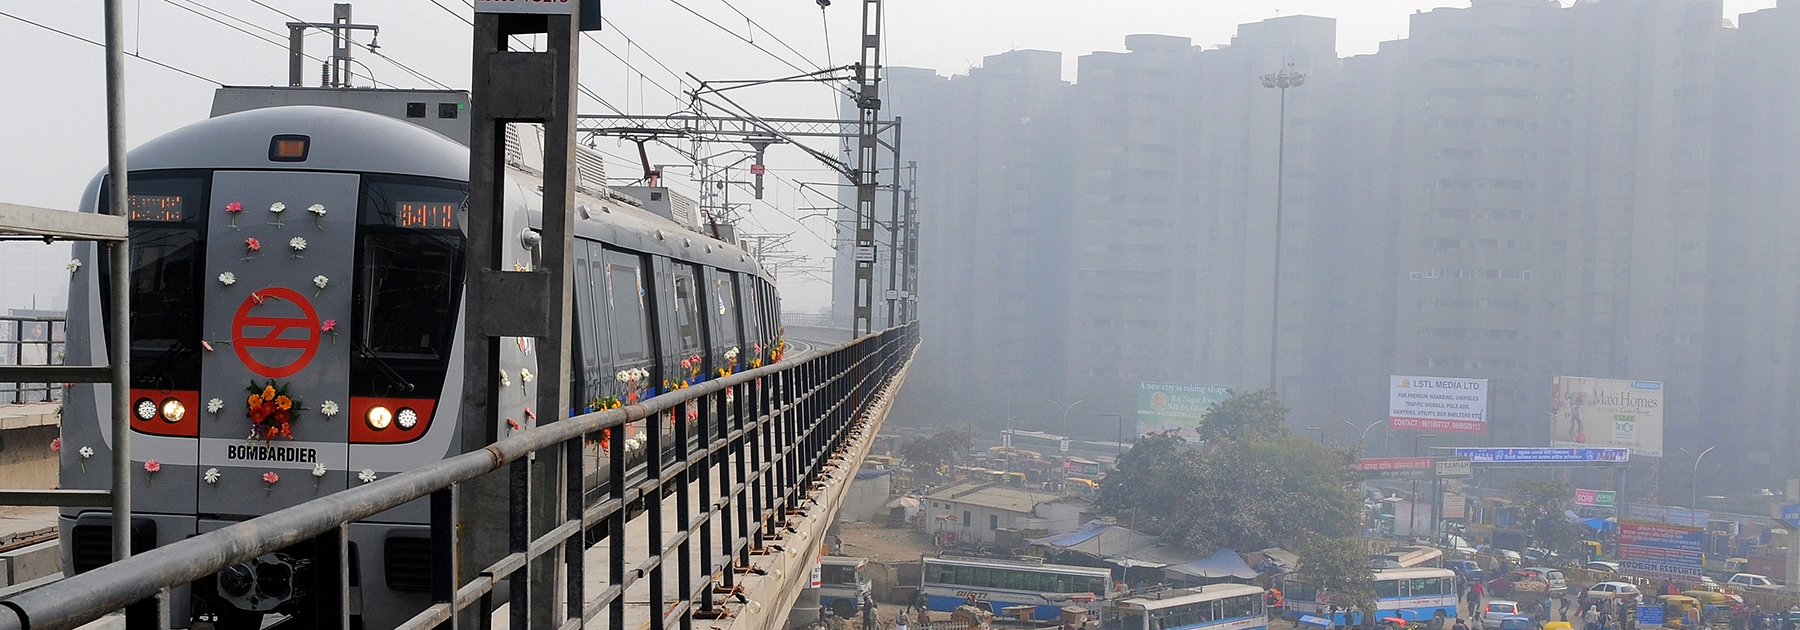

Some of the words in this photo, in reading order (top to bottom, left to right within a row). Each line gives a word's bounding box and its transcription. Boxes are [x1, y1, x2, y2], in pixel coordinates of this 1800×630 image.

[1162, 383, 1175, 393] city
[1184, 385, 1206, 394] taking
[1413, 380, 1433, 388] LSTL
[1435, 380, 1462, 389] MEDIA
[1464, 381, 1482, 390] LTD.
[1183, 396, 1201, 404] Nagar
[1593, 390, 1619, 406] Maxi
[1621, 391, 1658, 408] Homes
[1393, 419, 1418, 427] CONTACT
[228, 445, 317, 463] BOMBARDIER
[1577, 493, 1593, 503] sale
[1620, 561, 1657, 571] MODERN
[1660, 565, 1702, 576] ASSOCIATES
